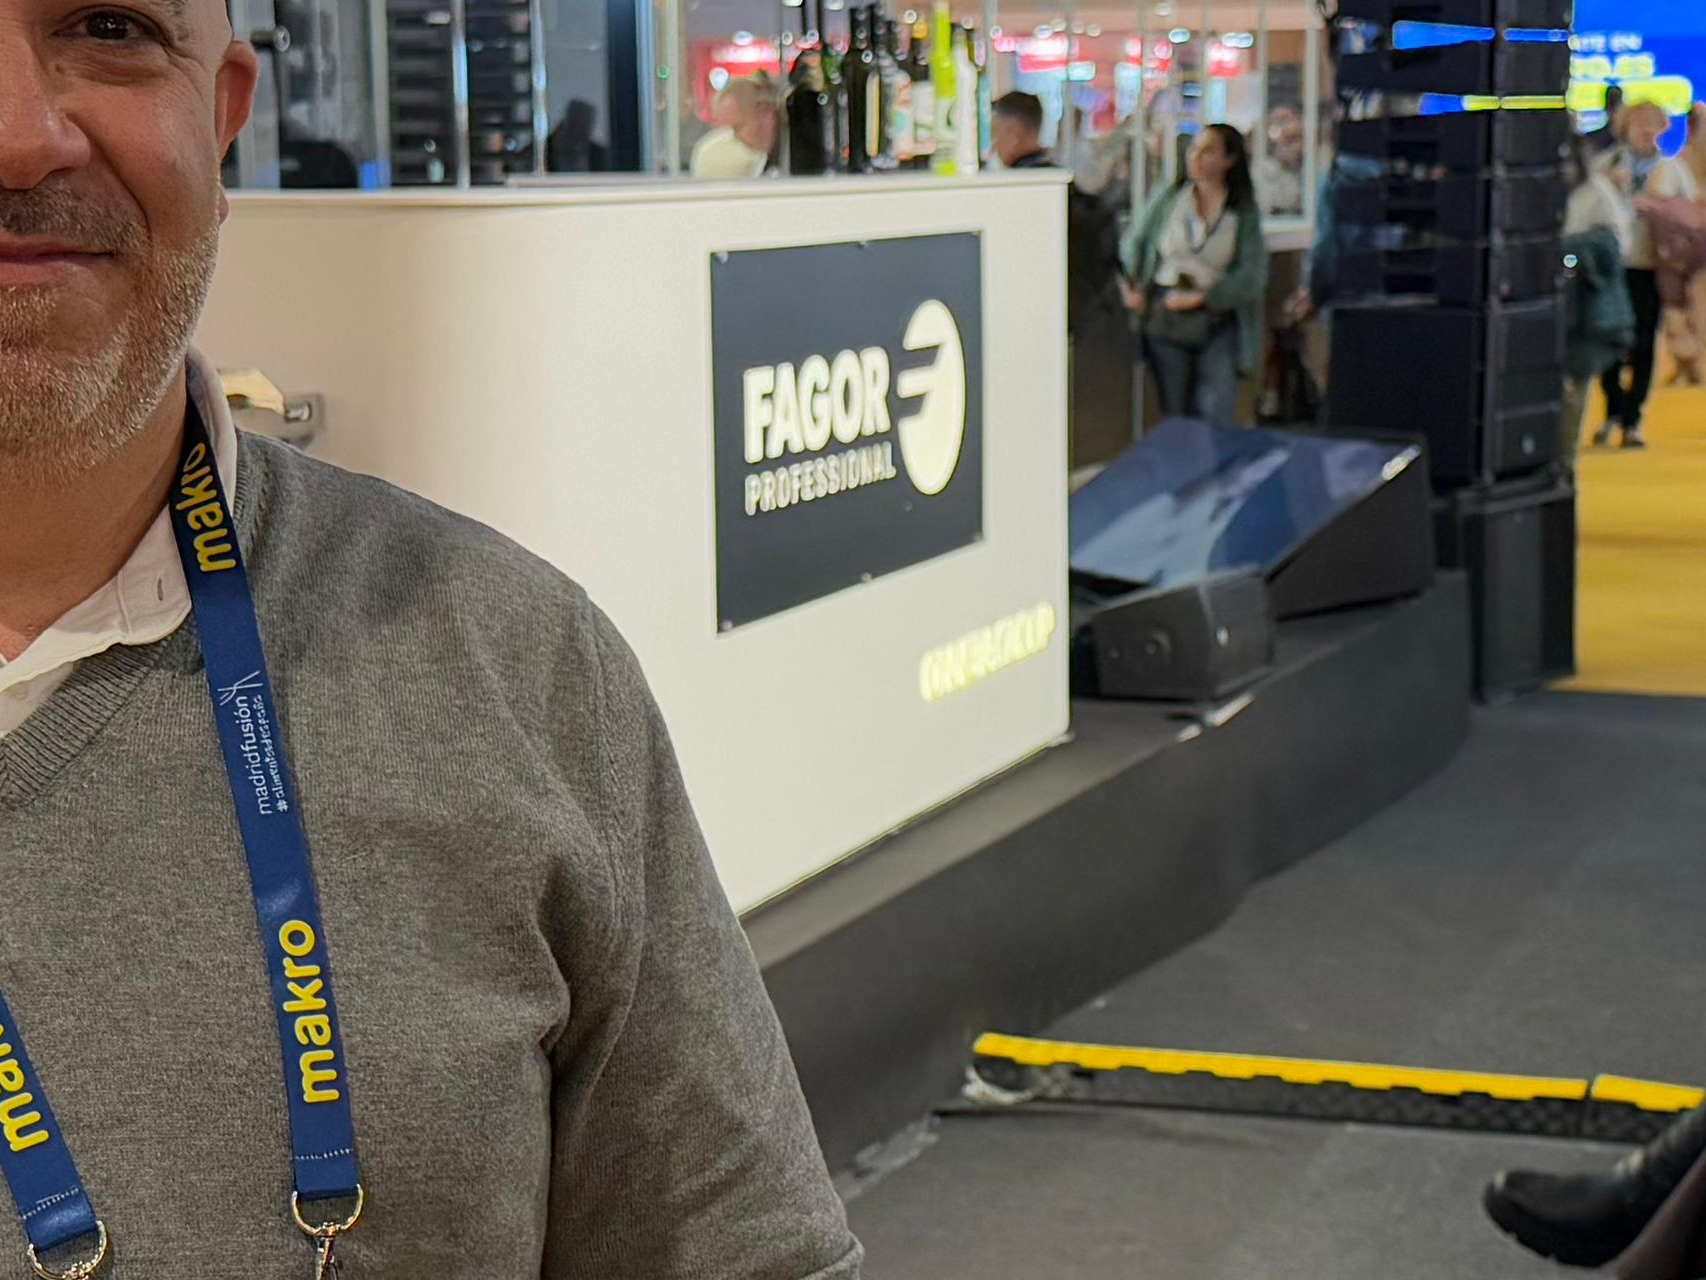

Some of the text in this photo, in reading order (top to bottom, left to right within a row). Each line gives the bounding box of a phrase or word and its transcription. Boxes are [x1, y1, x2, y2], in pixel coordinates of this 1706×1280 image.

[743, 346, 891, 464] FAGOR
[176, 442, 236, 572] makro
[744, 440, 896, 516] PROFESSIONAL
[234, 694, 273, 816] madridfusión
[278, 920, 340, 1104] makro
